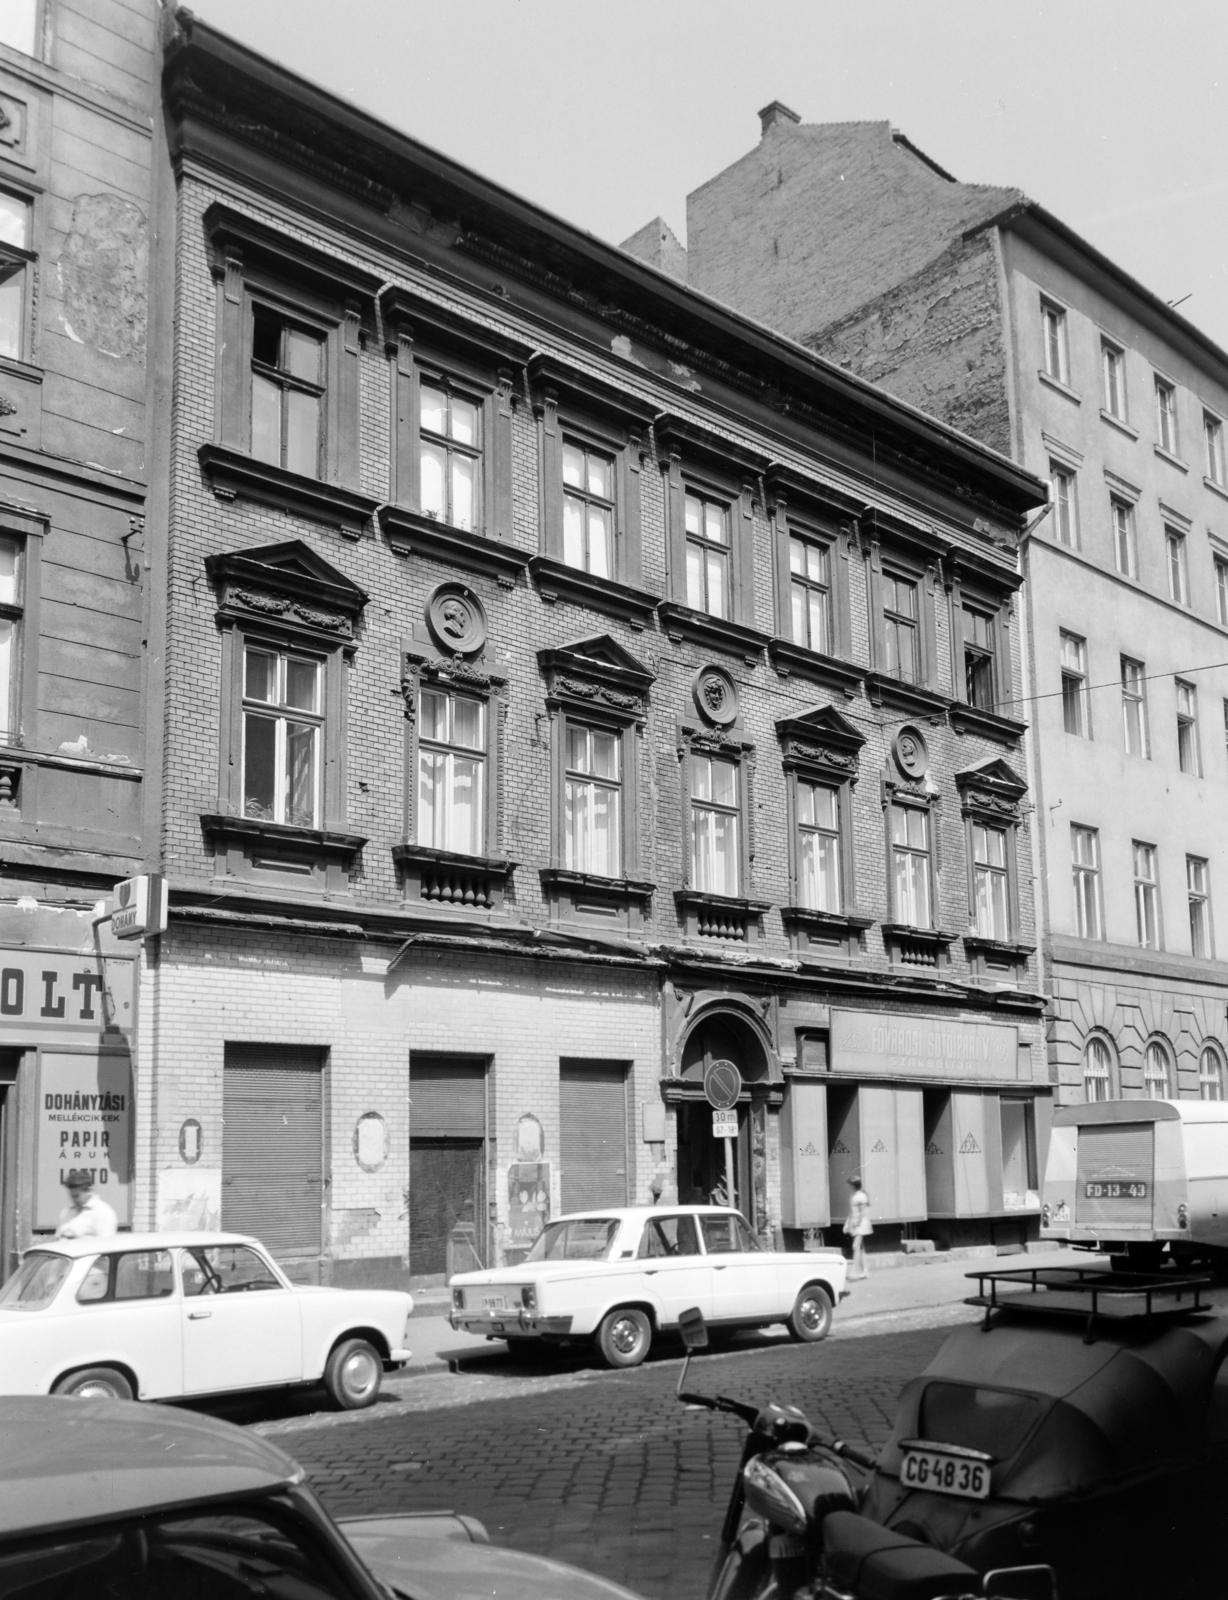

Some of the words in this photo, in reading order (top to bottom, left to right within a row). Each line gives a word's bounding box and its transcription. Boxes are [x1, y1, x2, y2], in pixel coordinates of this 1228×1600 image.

[111, 910, 137, 932] DOHÁNY
[872, 1023, 922, 1057] FŐVÁROSI
[890, 1056, 973, 1071] SZAKBOLTJA
[45, 1090, 125, 1111] DOHÁNYZÁSI
[48, 1112, 120, 1122] MELLÉKCIKKEK
[715, 1112, 726, 1122] 30
[59, 1149, 111, 1159] ÁRUK
